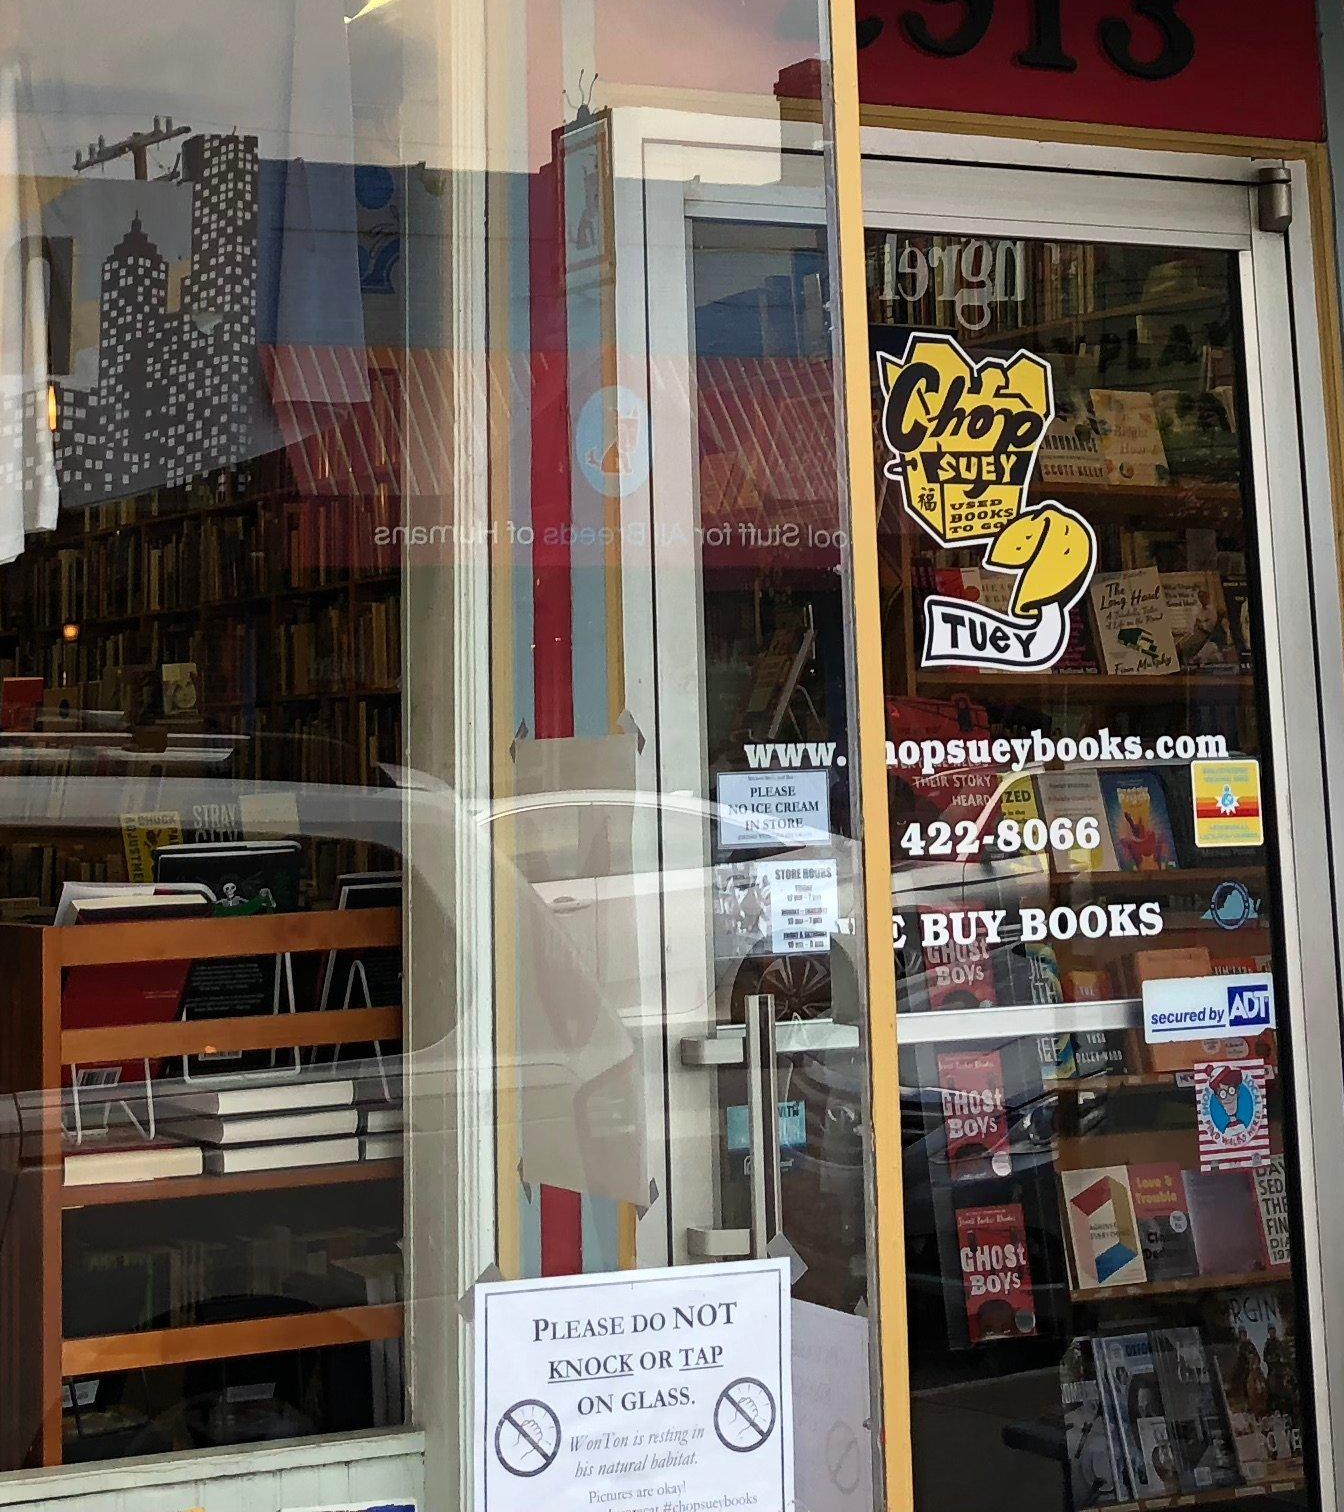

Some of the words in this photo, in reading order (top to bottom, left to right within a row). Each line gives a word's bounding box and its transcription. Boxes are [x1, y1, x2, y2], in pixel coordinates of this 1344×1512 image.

[884, 362, 1044, 460] Chop
[937, 452, 1017, 483] SUEY
[950, 498, 1003, 510] USED
[950, 508, 1014, 524] BOOKS
[950, 525, 974, 534] TO
[744, 728, 1229, 775] www.opsueybooks.com
[750, 786, 796, 798] PLEASE
[953, 774, 992, 788] STORY
[729, 804, 748, 816] NO
[751, 802, 772, 814] ICE
[775, 801, 820, 813] CREAM
[745, 819, 760, 831] IN
[762, 818, 804, 831] STORE
[901, 817, 1100, 856] 422-8066
[921, 909, 1006, 947] BUY
[1019, 901, 1164, 942] BOOKS
[1151, 1008, 1206, 1025] secured
[1208, 1007, 1225, 1025] by
[1229, 989, 1269, 1020] ADT
[533, 1315, 625, 1343] PLEASE
[632, 1312, 666, 1334] DO
[672, 1301, 738, 1329] NOT
[548, 1354, 634, 1382] KNOCK
[640, 1350, 673, 1372] OR
[678, 1345, 724, 1370] TAP
[577, 1394, 614, 1417] ON
[621, 1386, 696, 1412] GLASS.
[633, 1425, 644, 1446] is
[648, 1425, 689, 1447] resting
[692, 1423, 705, 1440] in
[598, 1454, 647, 1476] natural
[589, 1489, 633, 1504] Pictures
[637, 1488, 655, 1499] are
